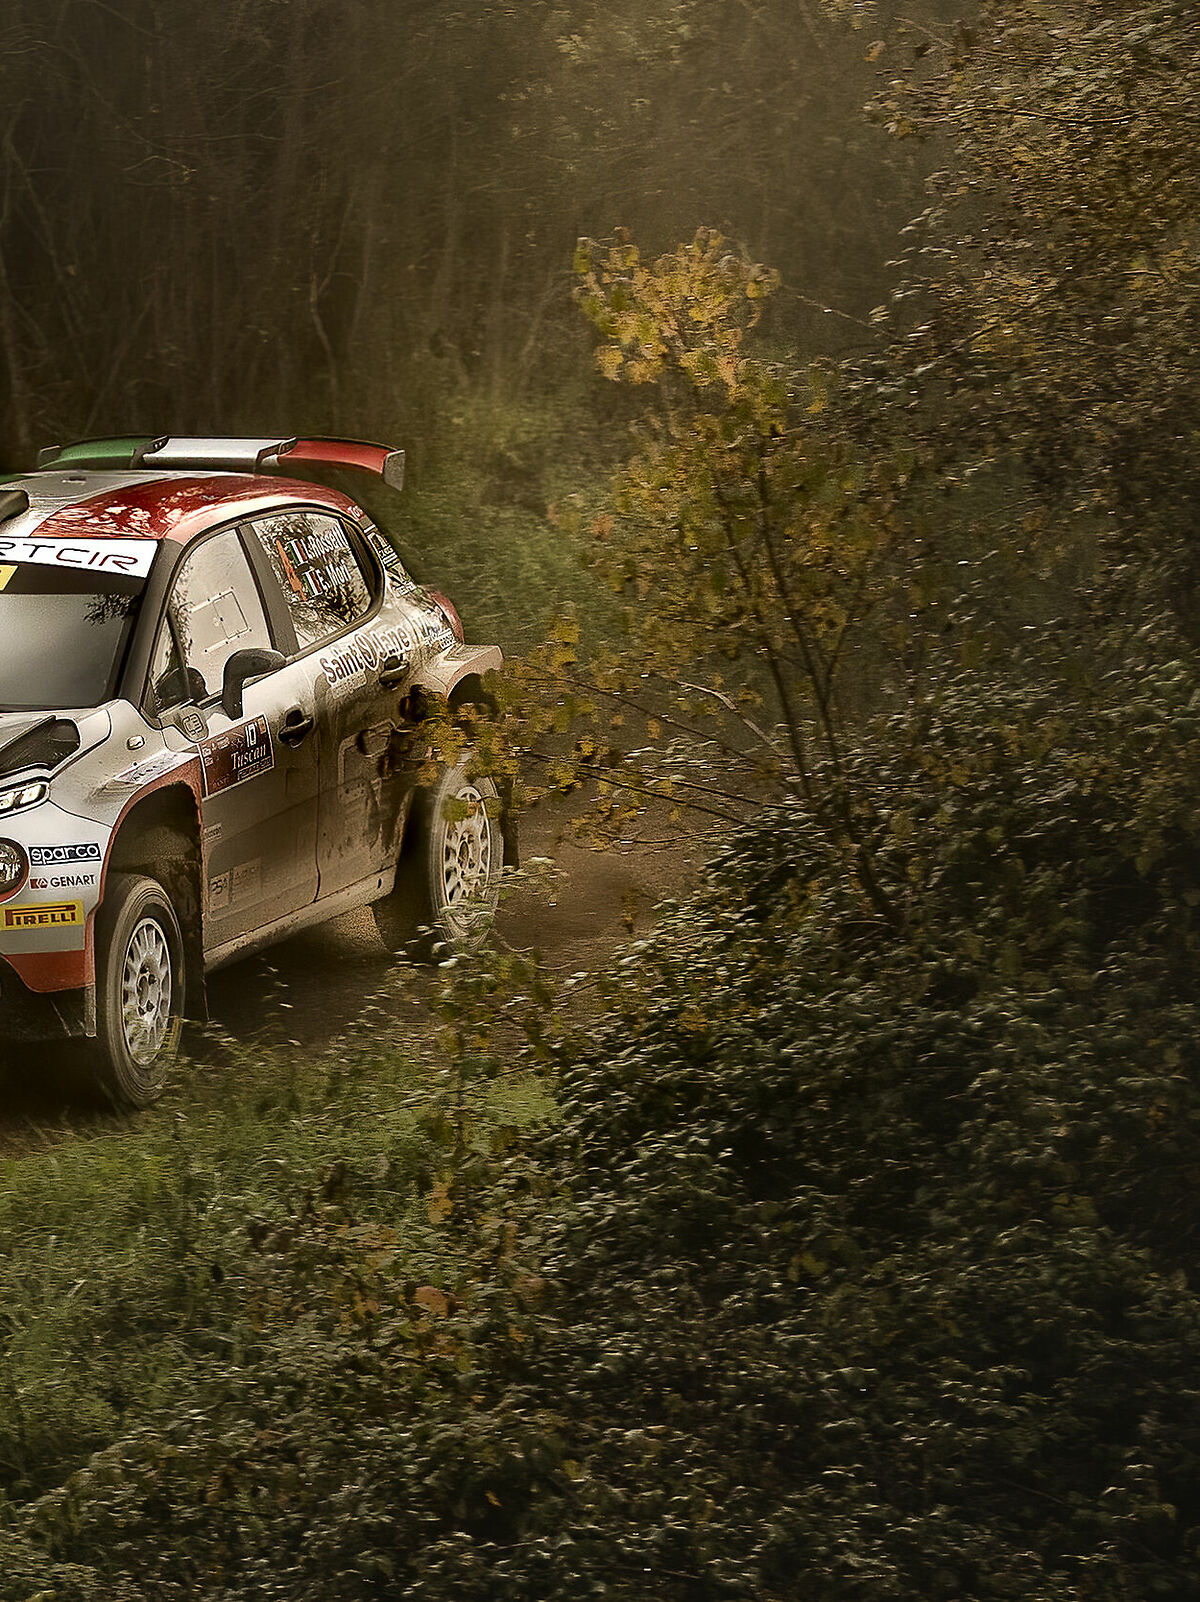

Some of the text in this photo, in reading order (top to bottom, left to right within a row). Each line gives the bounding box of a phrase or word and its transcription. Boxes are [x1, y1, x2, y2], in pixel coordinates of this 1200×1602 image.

[319, 645, 366, 684] Saint
[231, 744, 266, 770] Tuscan
[31, 845, 99, 865] sparco
[50, 875, 94, 888] GENART
[5, 905, 76, 926] PIRELLI
